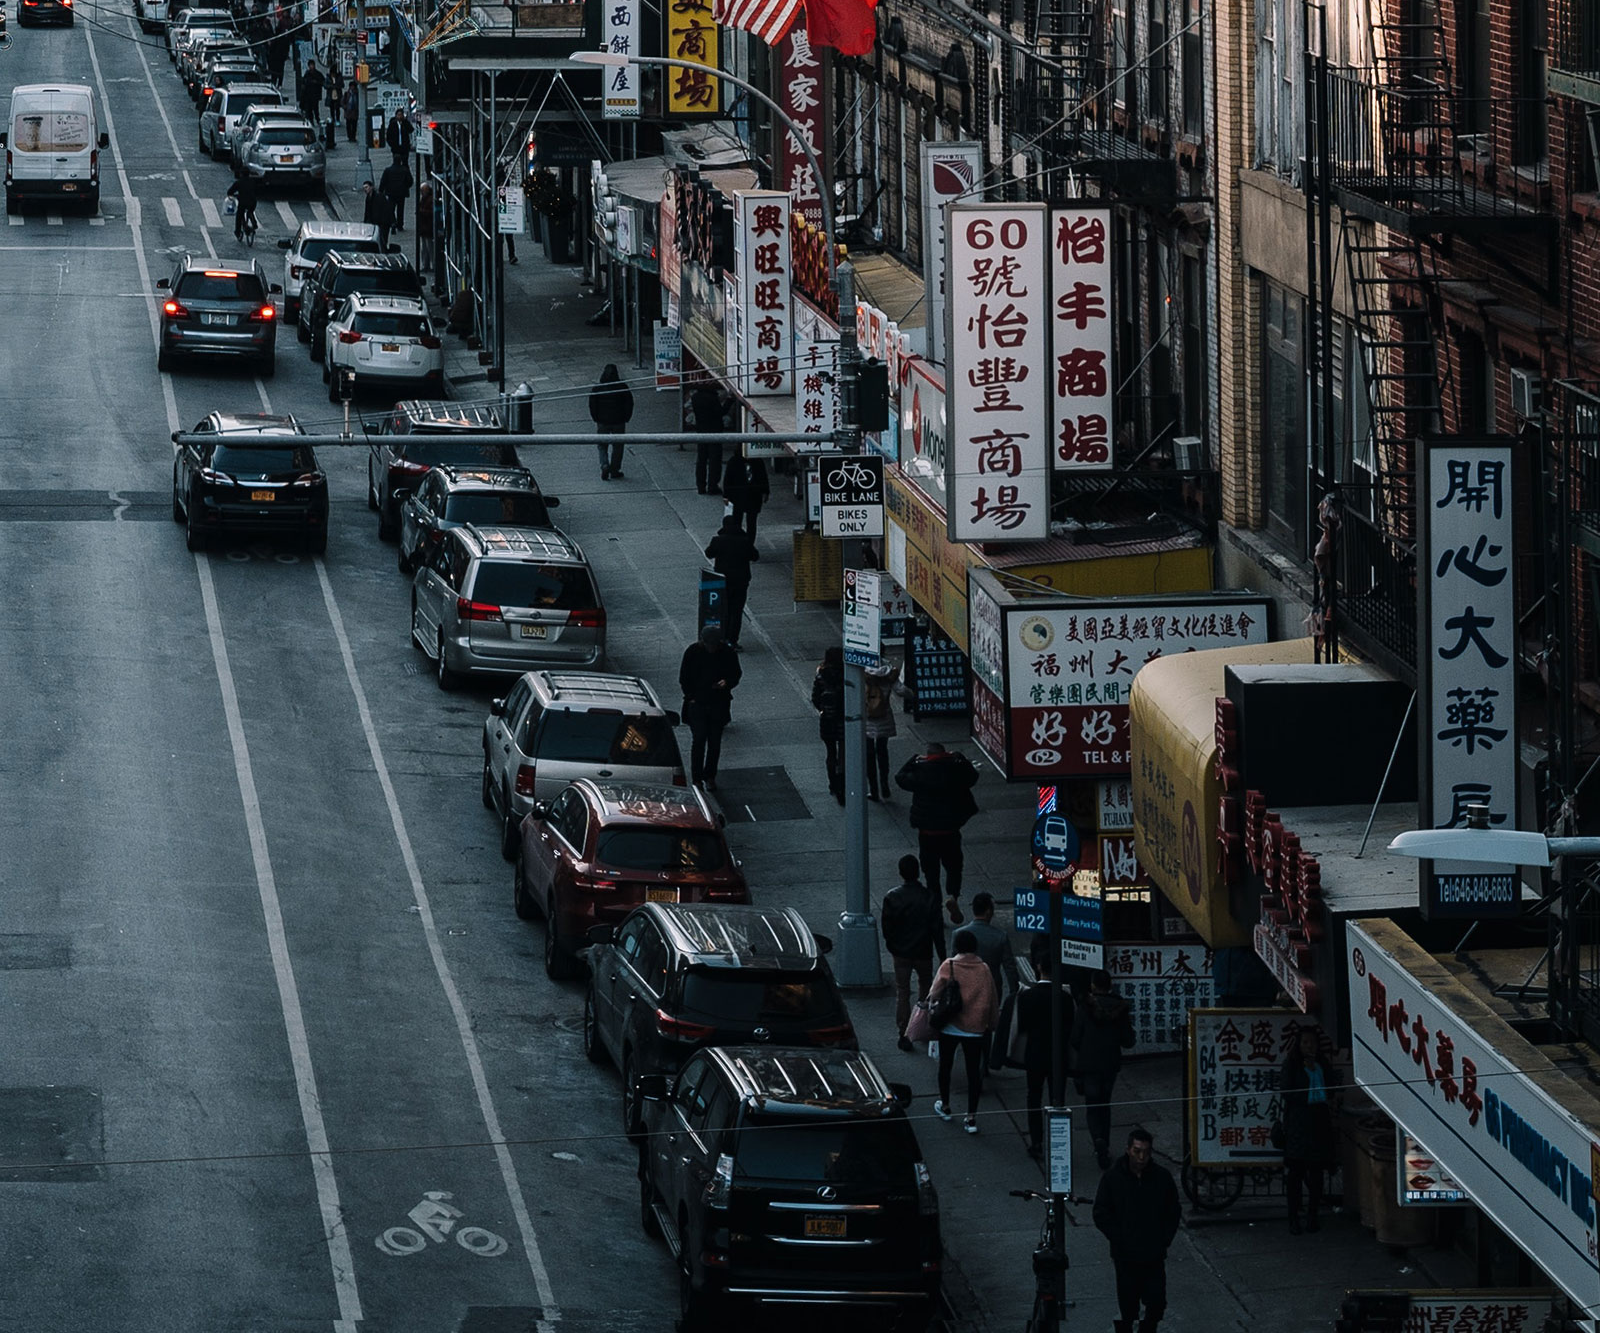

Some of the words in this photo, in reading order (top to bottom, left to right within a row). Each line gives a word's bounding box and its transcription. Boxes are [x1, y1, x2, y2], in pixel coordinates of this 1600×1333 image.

[752, 205, 786, 391] 興旺旺商場
[824, 493, 847, 503] BIKE
[852, 492, 880, 502] LANE
[837, 510, 868, 520] BIKES
[839, 522, 867, 533] ONLY
[708, 591, 718, 606] P
[846, 601, 854, 615] 2
[1436, 459, 1509, 830] 開心大藥房
[1033, 749, 1054, 765] 62
[1082, 751, 1108, 764] TEL
[1110, 750, 1122, 764] &
[1035, 858, 1045, 872] NO
[1043, 863, 1076, 880] STANDING
[1438, 876, 1513, 904] Tel:646-848-6683
[1016, 892, 1036, 908] M9
[1016, 914, 1046, 931] M22
